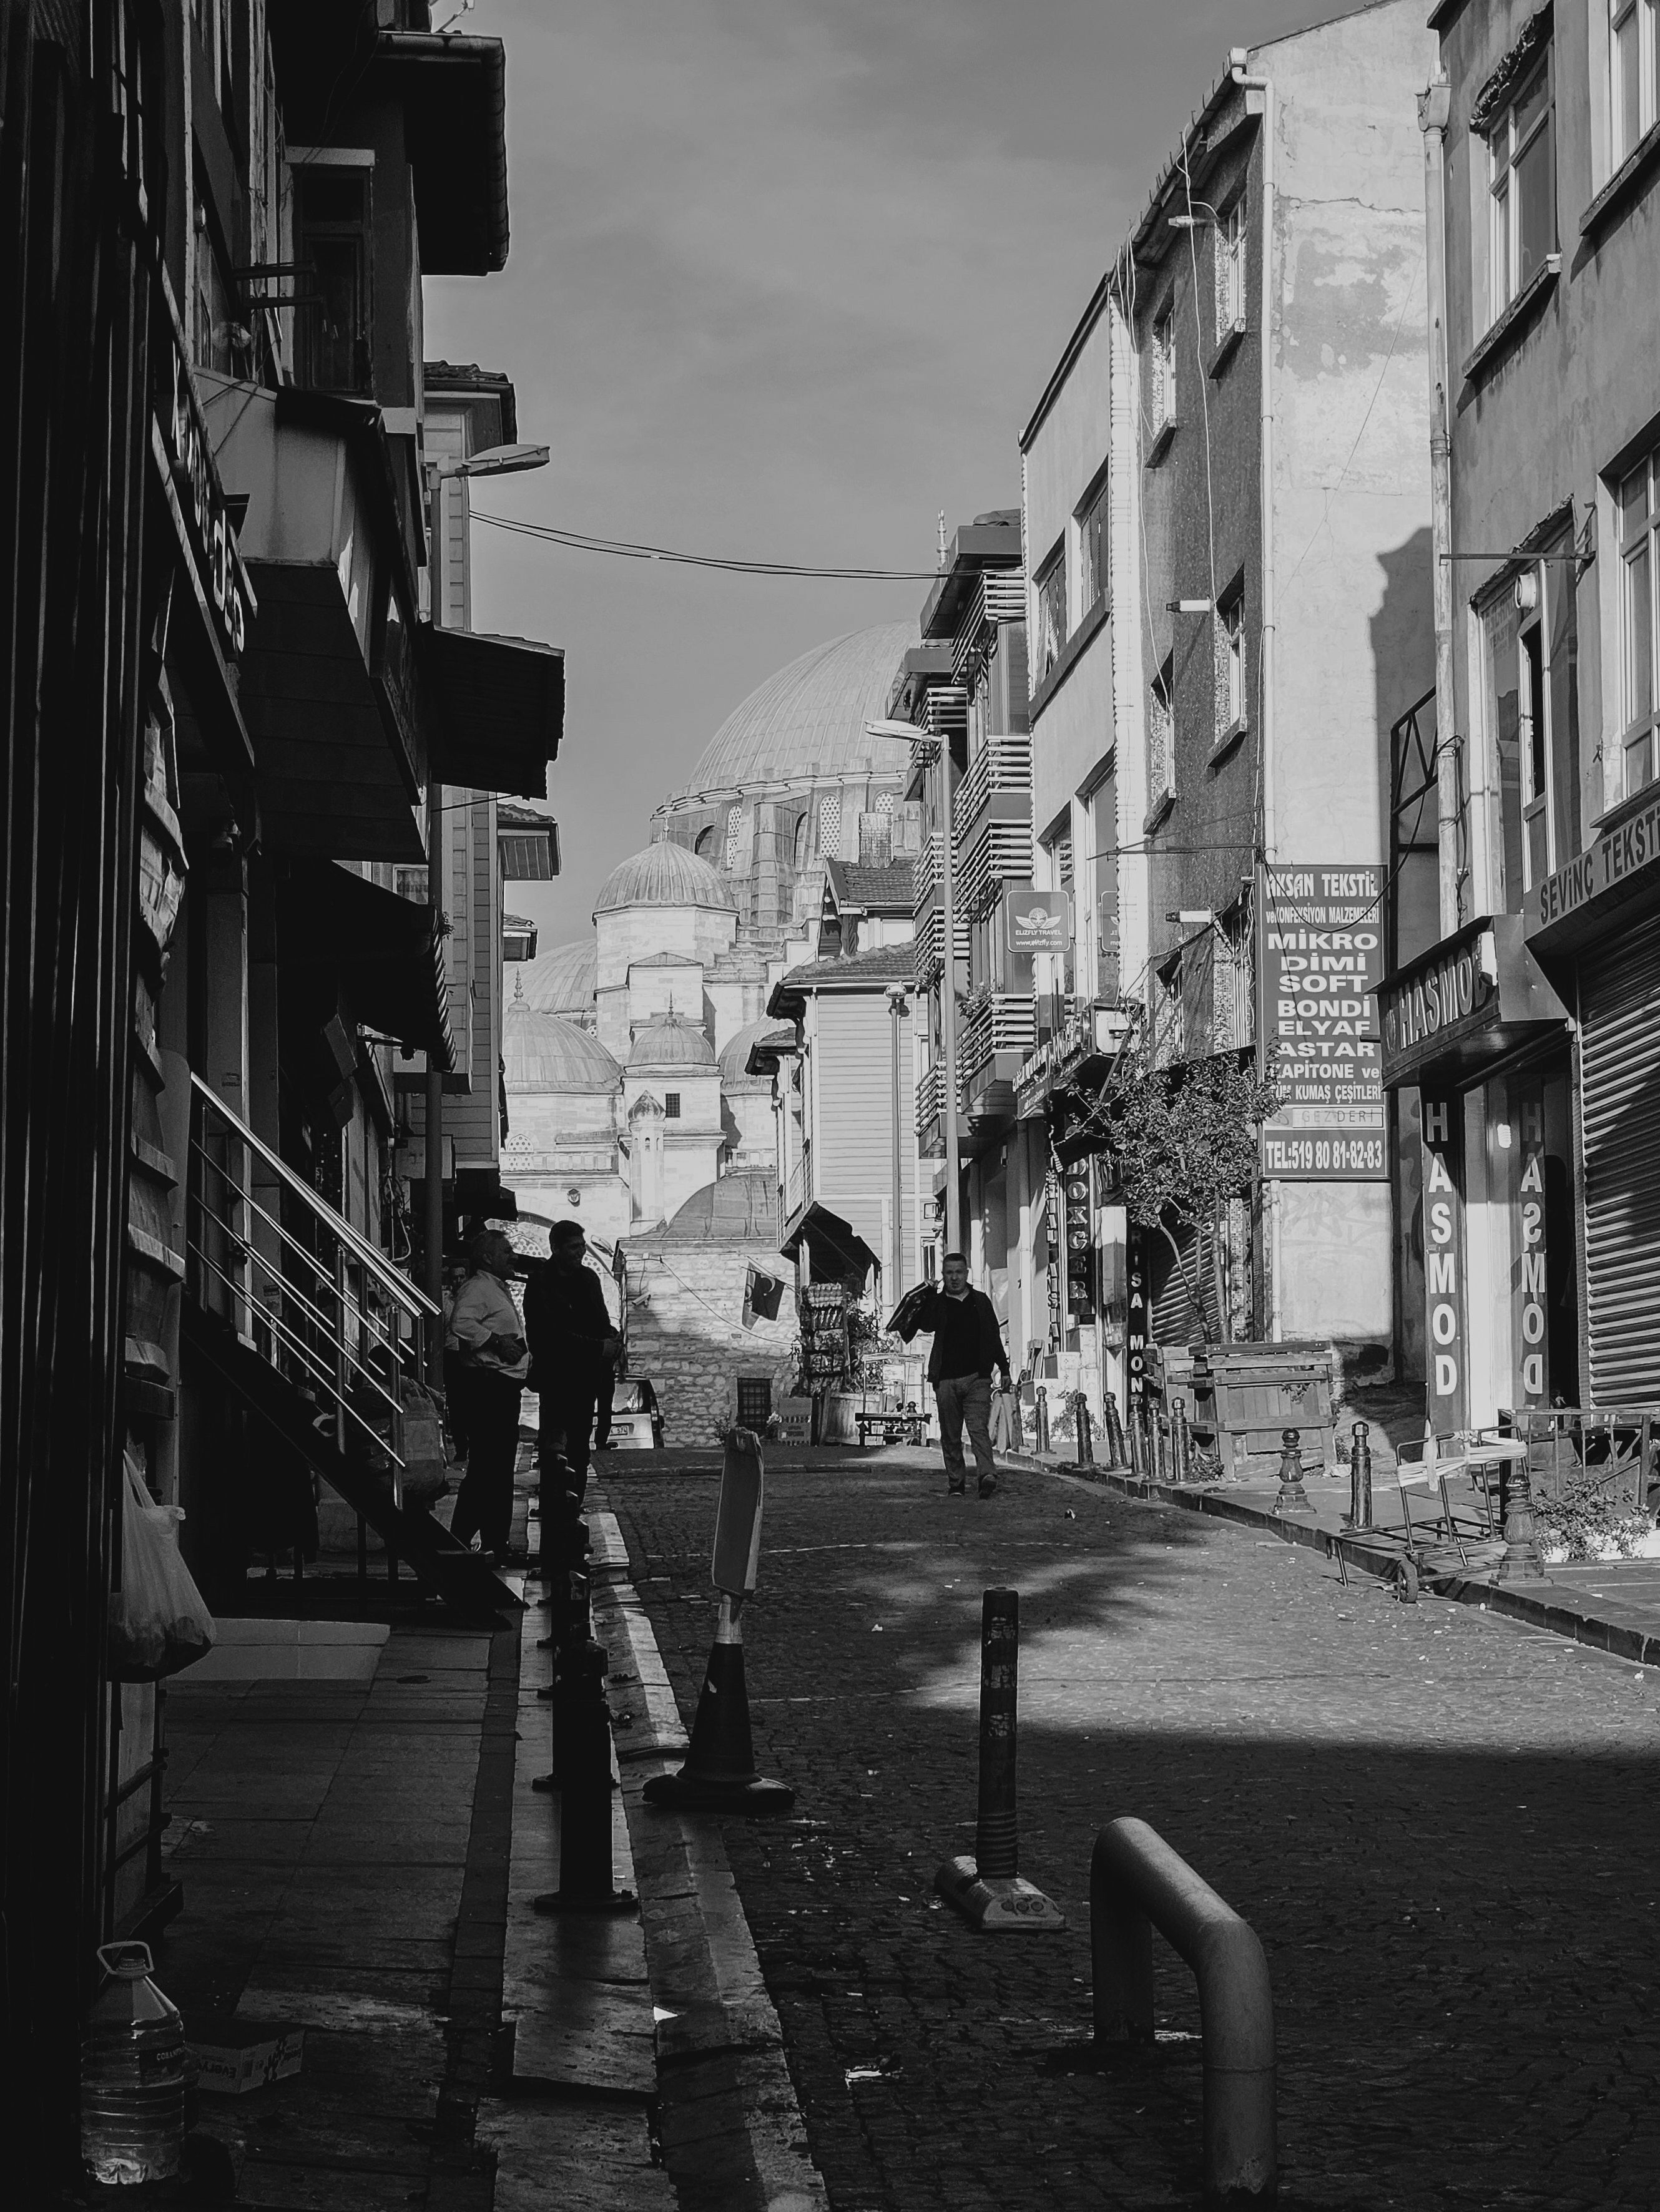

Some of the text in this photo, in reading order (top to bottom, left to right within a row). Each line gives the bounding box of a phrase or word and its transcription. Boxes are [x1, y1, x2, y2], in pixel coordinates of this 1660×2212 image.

[1265, 871, 1378, 899] AKSAN TEKSTİL
[1540, 853, 1594, 925] SEVİNÇ
[1275, 902, 1326, 924] KONFEKSİYON
[1328, 903, 1379, 924] MALZEMELERİ
[1268, 928, 1378, 950] MİKRO
[1280, 952, 1367, 971] DİMİ
[1279, 975, 1368, 994] SOFT
[1277, 995, 1370, 1017] BONDİ
[1277, 1020, 1370, 1035] ELYAF
[1277, 1042, 1375, 1057] ASTAR
[1361, 1067, 1380, 1079] ve
[1295, 1084, 1331, 1104] KUMAŞ
[1335, 1081, 1381, 1104] ÇEŞİTLERİ
[1266, 1140, 1382, 1169] TEL:519 80 81-82-83
[1426, 1102, 1458, 1396] HASMOD
